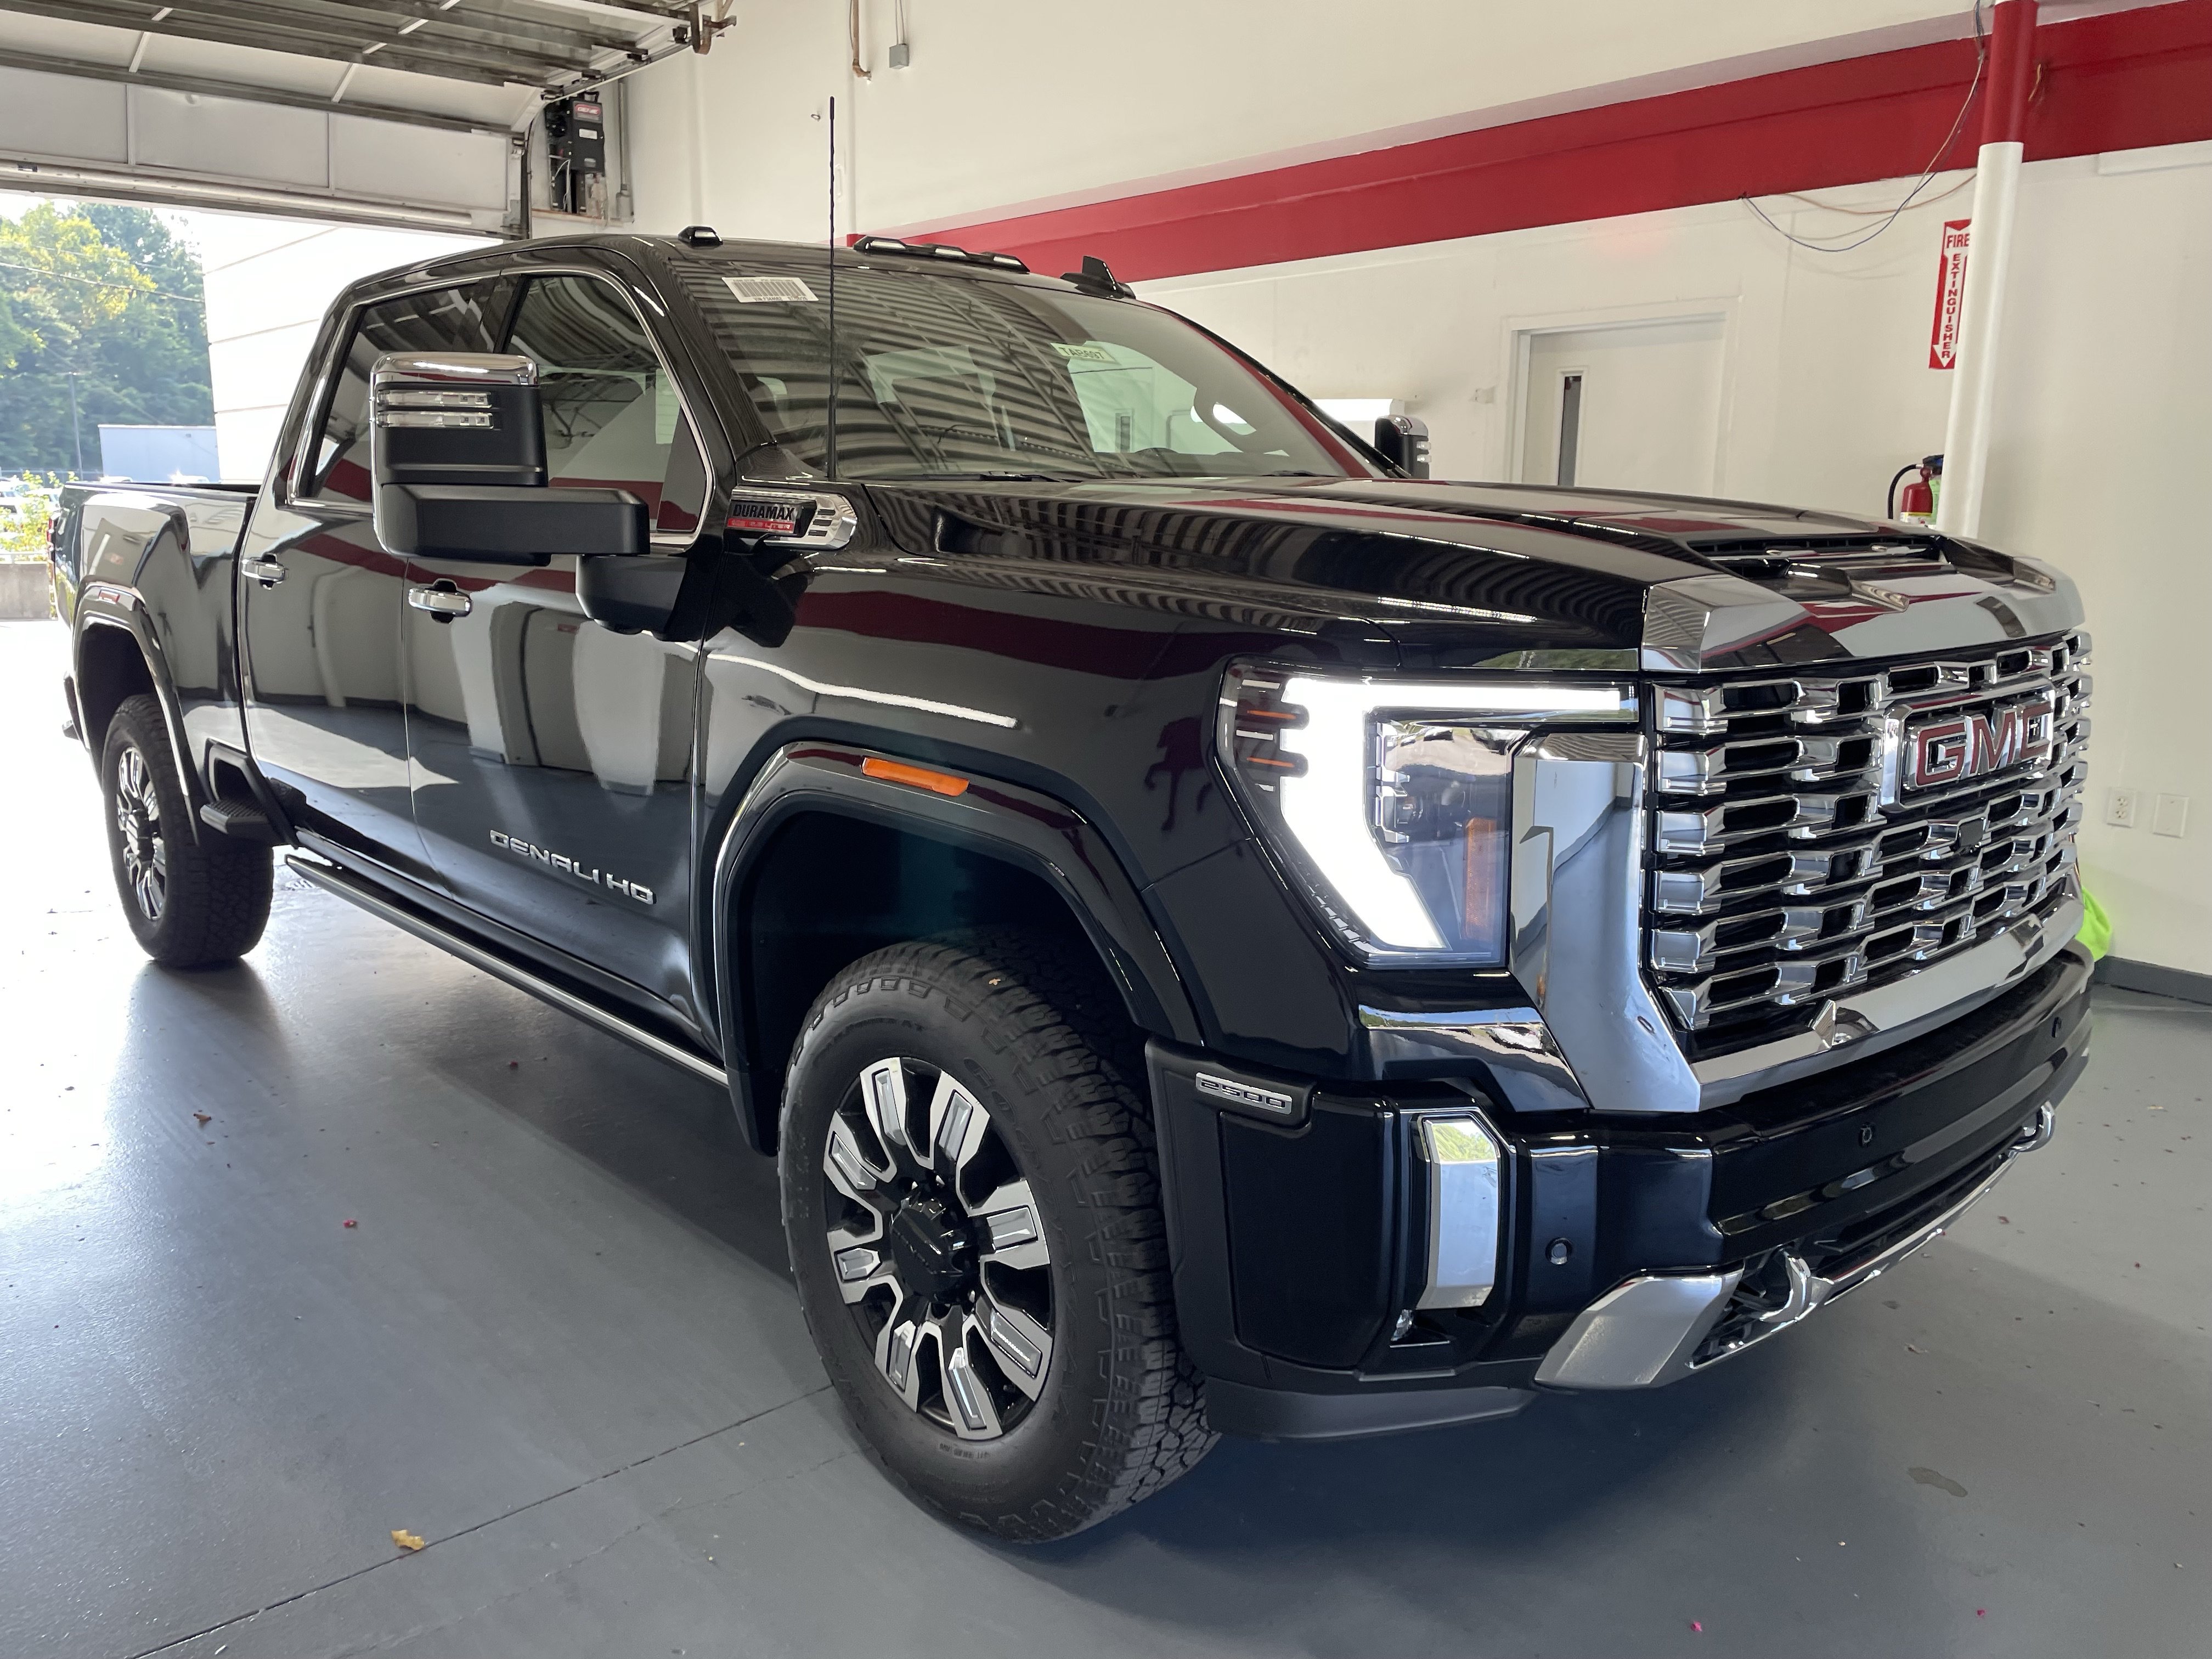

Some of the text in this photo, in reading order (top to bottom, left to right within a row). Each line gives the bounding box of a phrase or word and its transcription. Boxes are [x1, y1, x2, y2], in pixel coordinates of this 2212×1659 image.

[1946, 233, 1970, 249] FIRE
[1942, 253, 1961, 358] EXTINGUISHER
[732, 504, 795, 520] DURAMAX
[1915, 701, 2052, 788] GMC
[489, 830, 654, 905] DENALI HD
[1200, 1079, 1286, 1109] 2500
